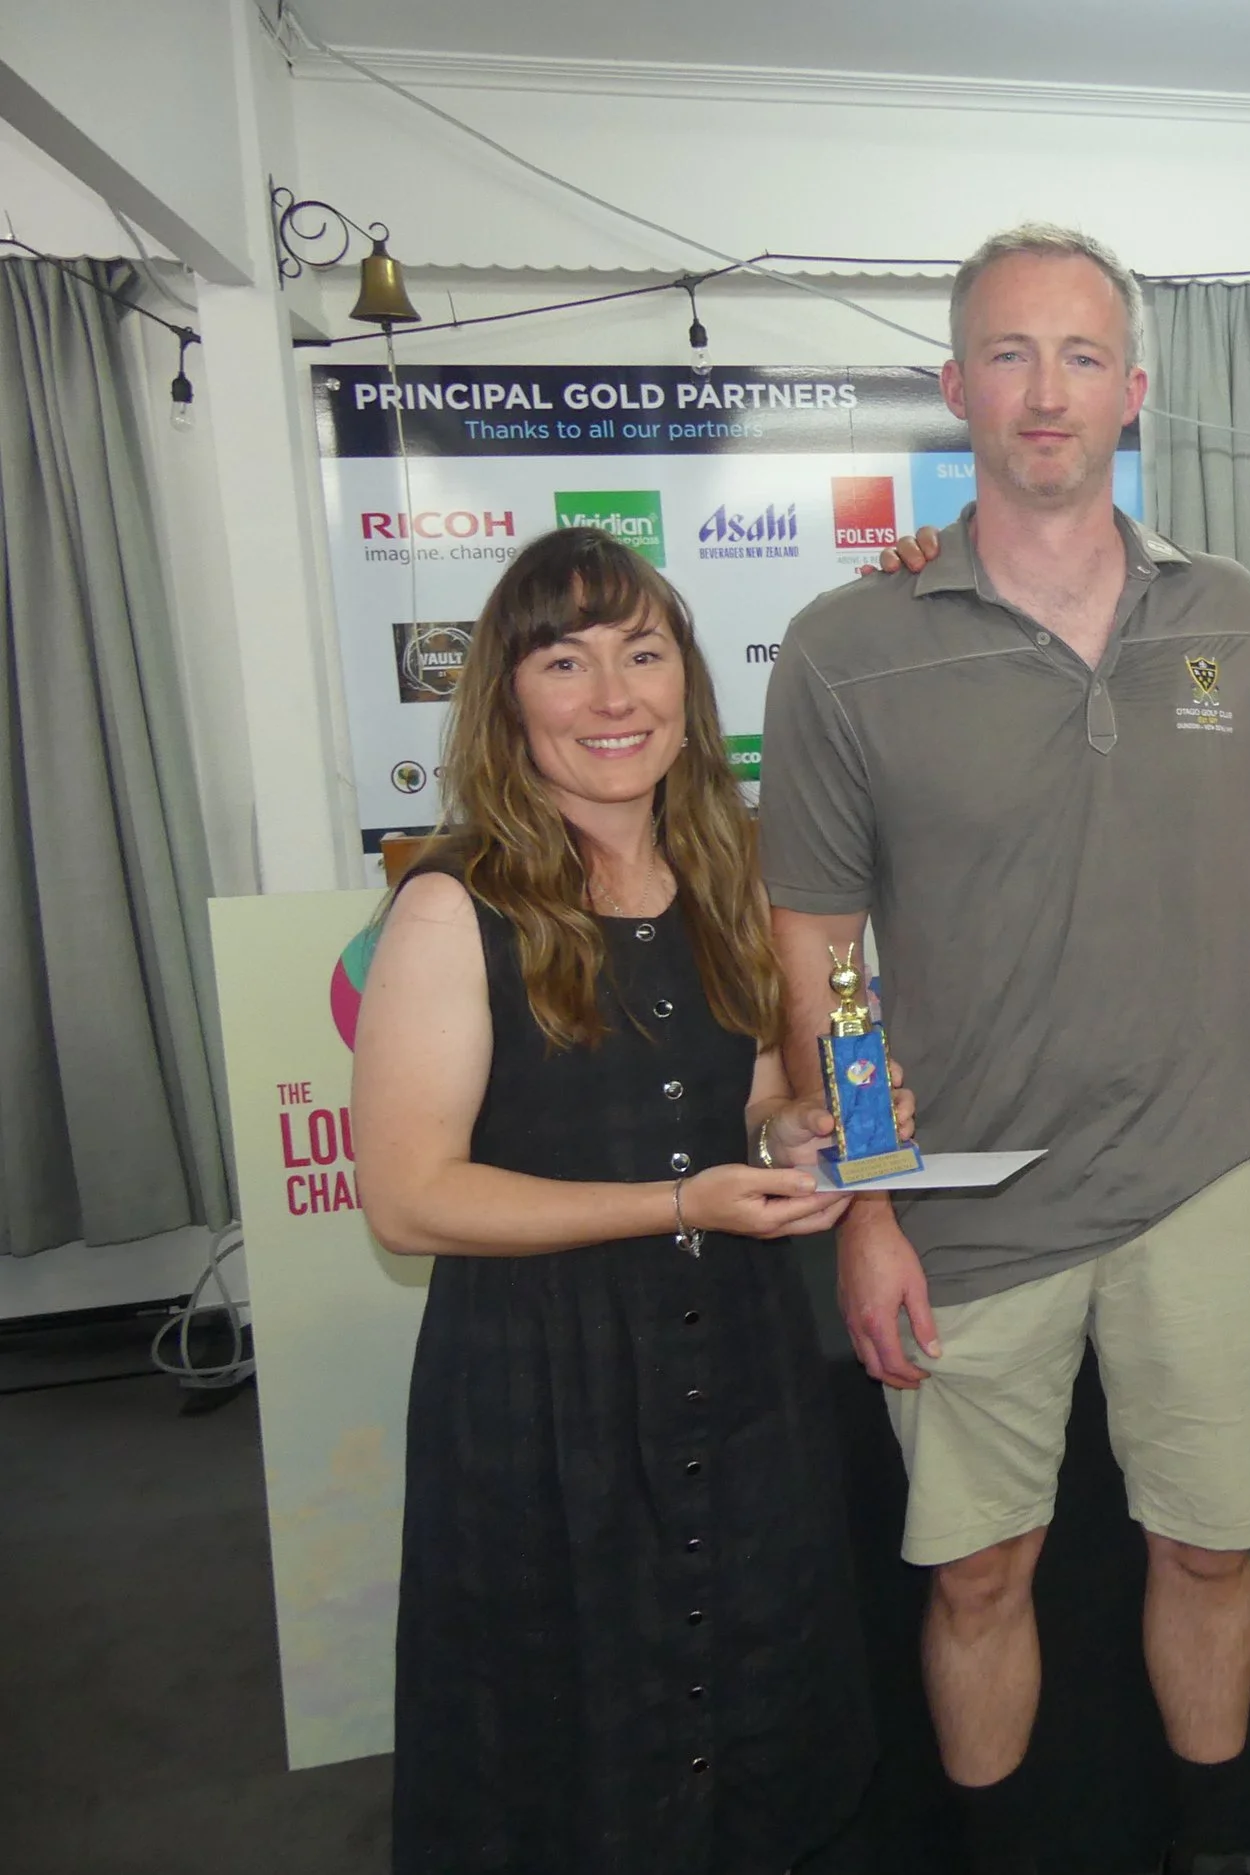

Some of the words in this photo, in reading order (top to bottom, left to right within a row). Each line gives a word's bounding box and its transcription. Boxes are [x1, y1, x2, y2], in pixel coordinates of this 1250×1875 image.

[354, 383, 553, 410] PRINCIPAL
[563, 383, 665, 410] GOLD
[676, 383, 858, 409] PARTNERS
[465, 420, 549, 439] Thanks
[557, 421, 581, 438] to
[589, 420, 615, 438] all
[622, 423, 660, 438] our
[668, 421, 763, 441] partners
[361, 511, 515, 539] RICOH
[698, 503, 798, 543] Asahi
[836, 528, 895, 544] FOLEYS
[699, 547, 744, 560] BEVERAGES
[745, 546, 763, 558] NEW
[766, 546, 799, 558] ZEALAND
[420, 652, 463, 665] VAULT
[276, 1081, 313, 1105] THE
